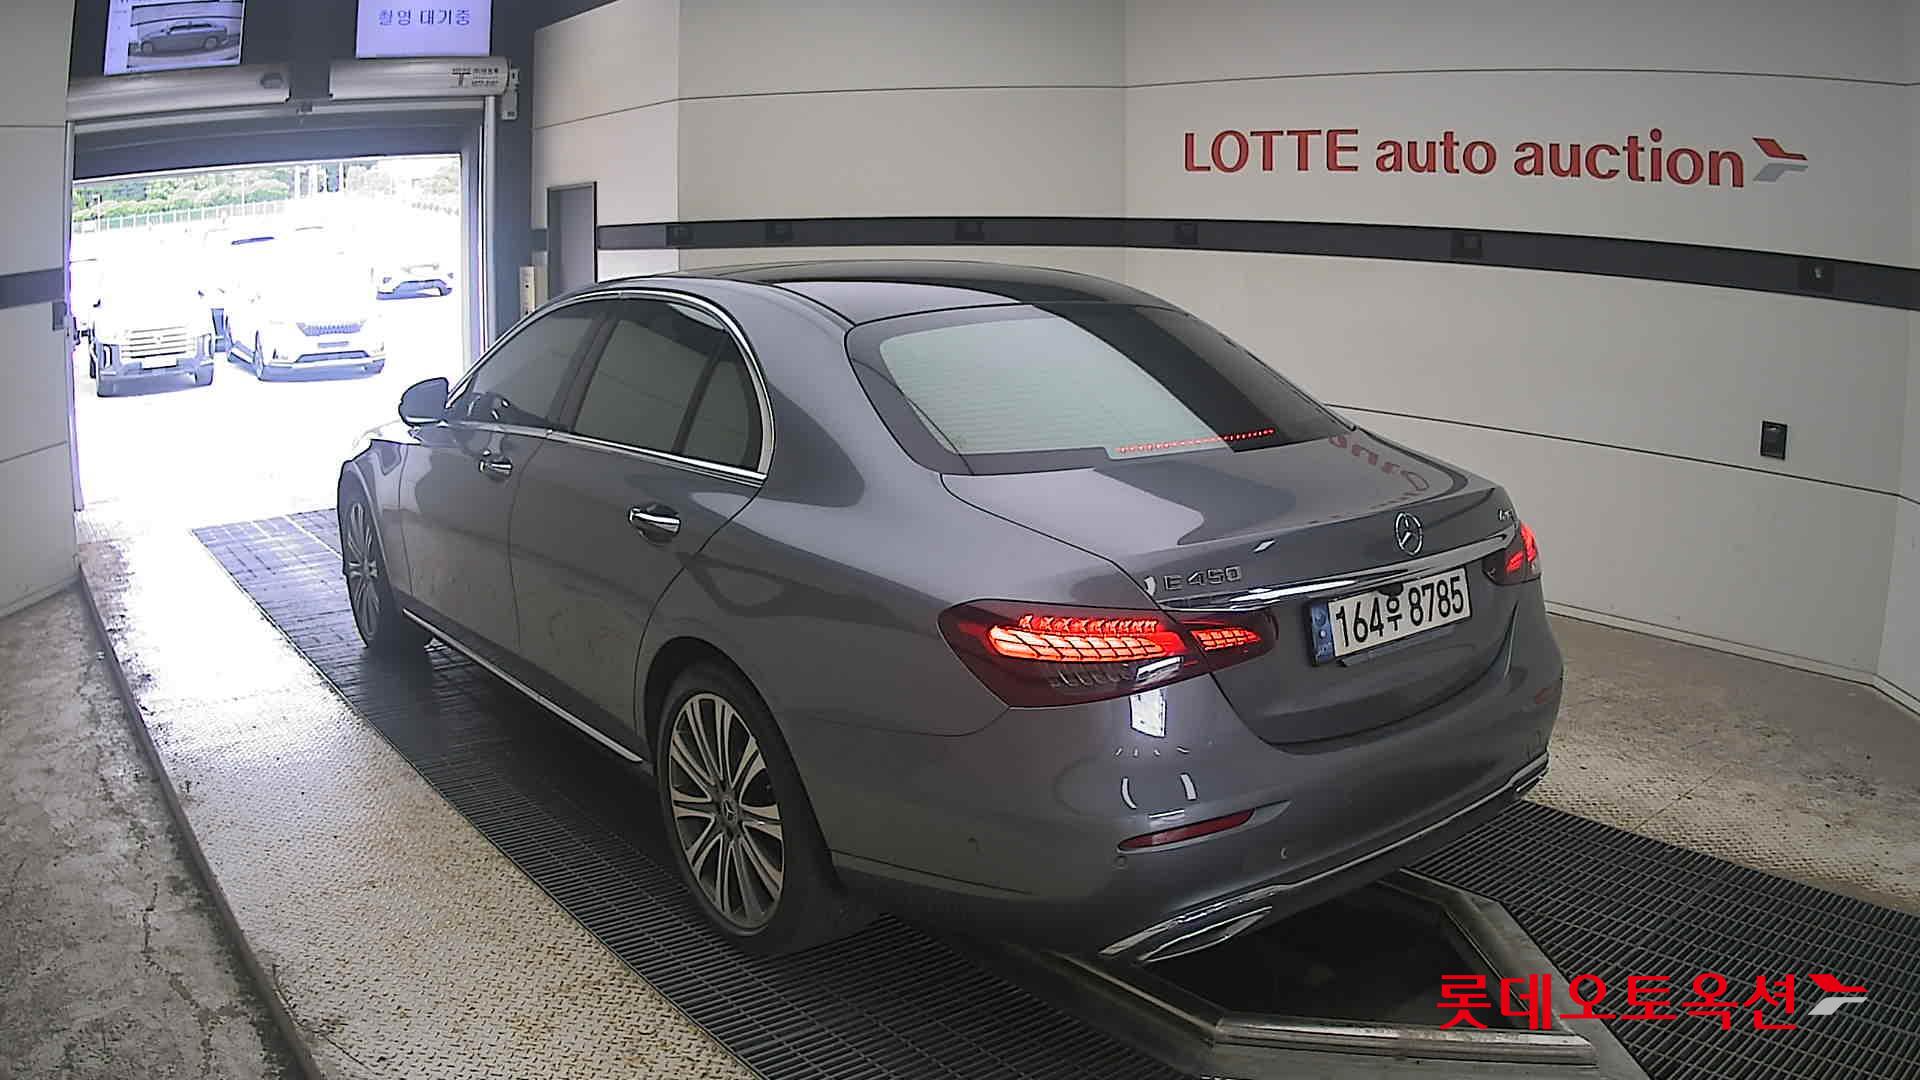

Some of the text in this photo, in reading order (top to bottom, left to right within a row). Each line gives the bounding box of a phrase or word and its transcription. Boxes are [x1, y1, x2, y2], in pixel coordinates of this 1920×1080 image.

[419, 8, 471, 26] 대기중
[1184, 128, 1744, 189] LOTTE auto auction
[1187, 564, 1243, 587] 450
